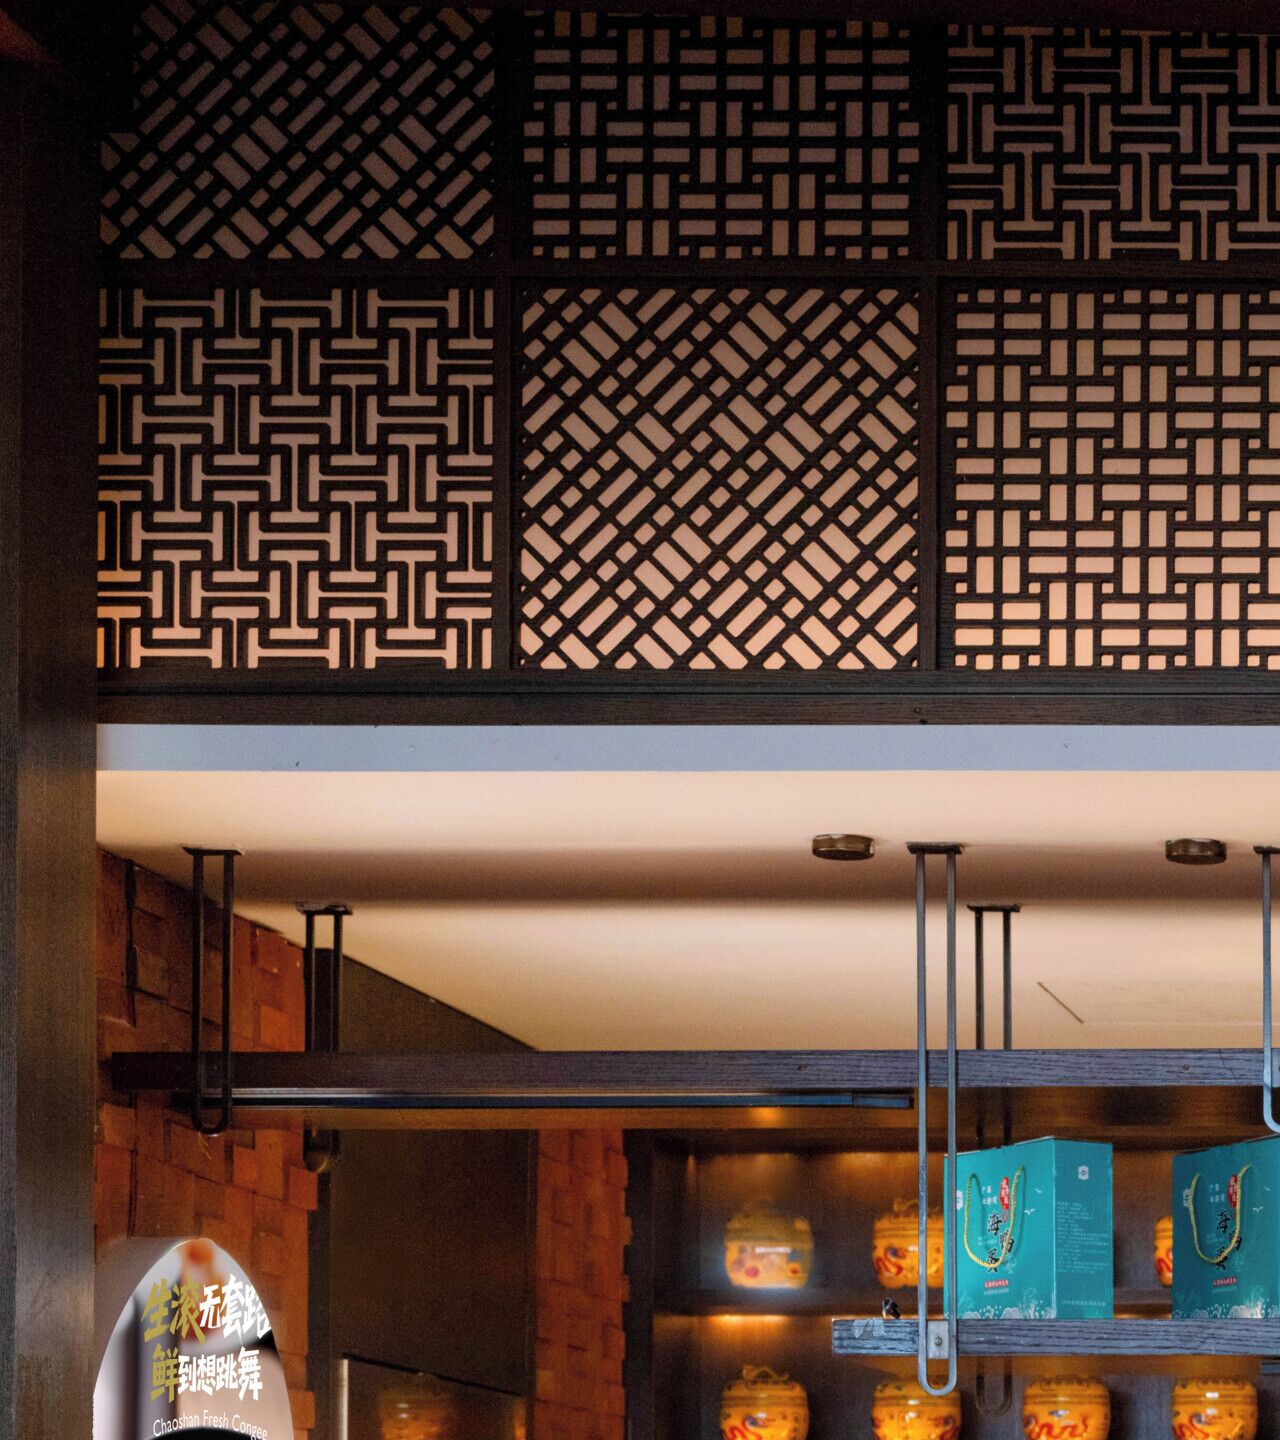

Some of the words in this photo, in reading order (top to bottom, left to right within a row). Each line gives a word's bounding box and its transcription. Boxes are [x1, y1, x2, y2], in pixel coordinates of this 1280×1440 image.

[140, 1273, 273, 1346] 生滚无套路
[150, 1343, 263, 1404] 鲜到想跳舞
[153, 1411, 200, 1438] Chaoshan
[203, 1409, 229, 1430] Fresh
